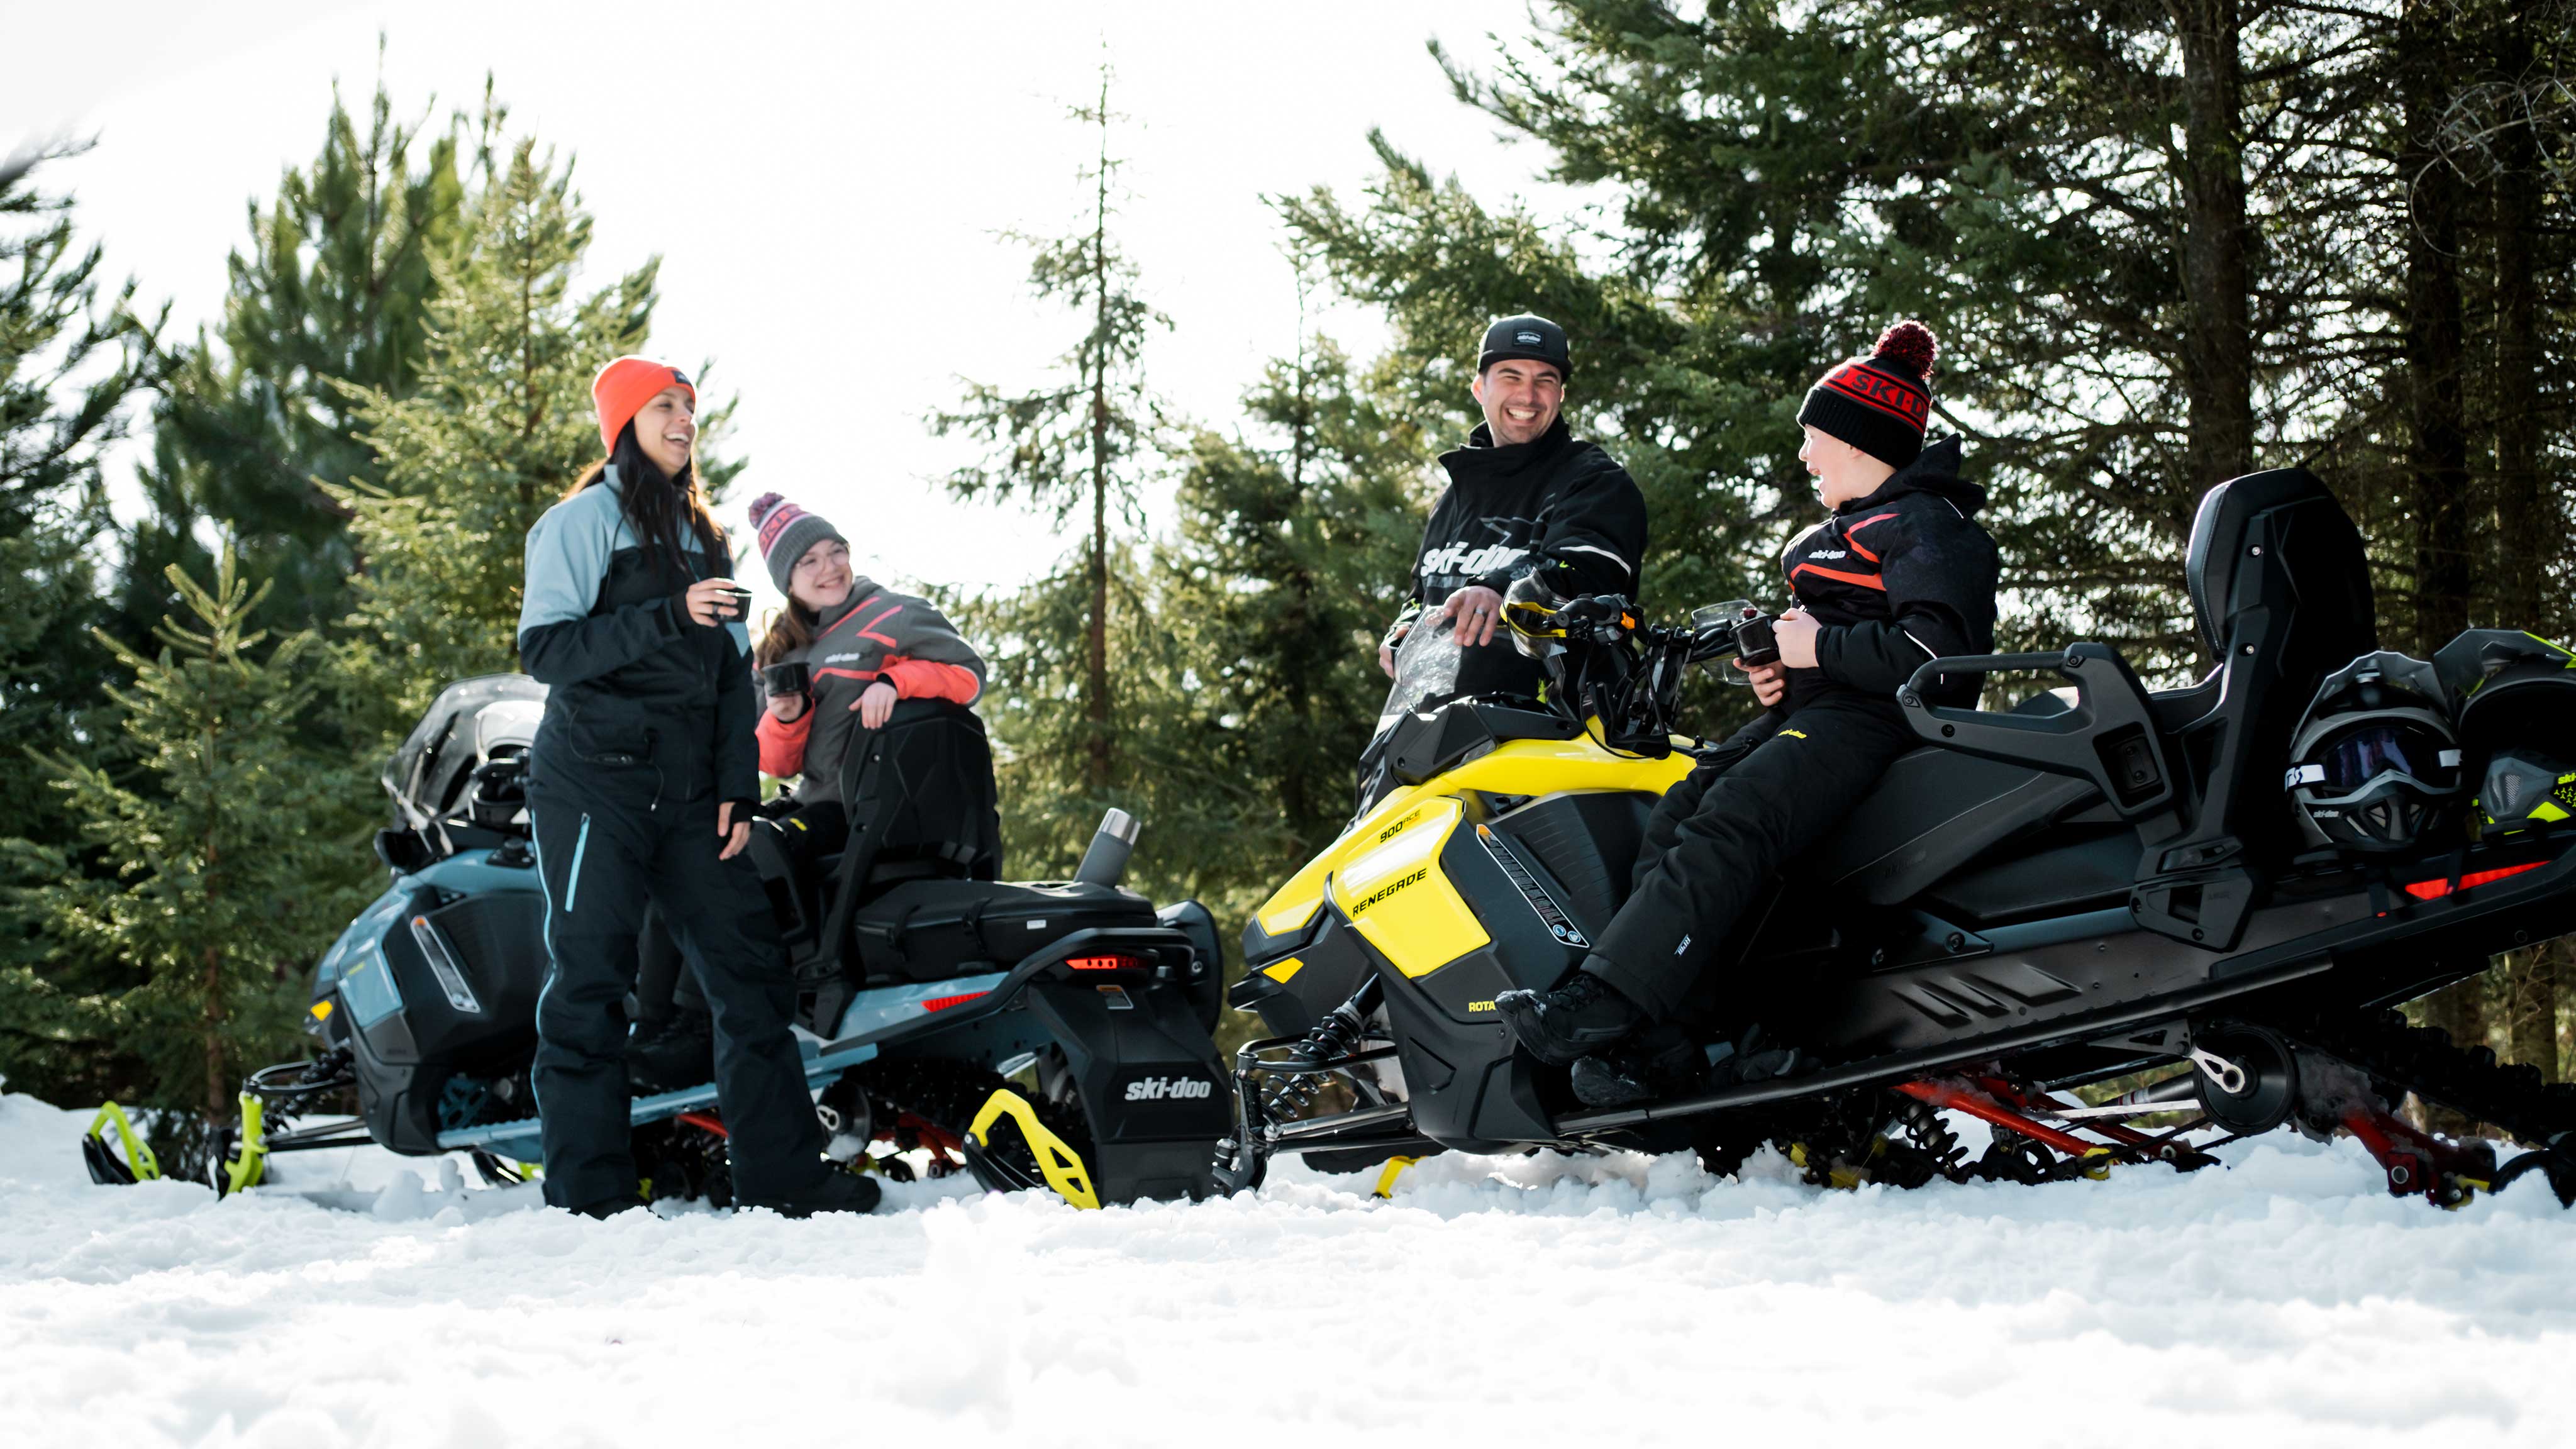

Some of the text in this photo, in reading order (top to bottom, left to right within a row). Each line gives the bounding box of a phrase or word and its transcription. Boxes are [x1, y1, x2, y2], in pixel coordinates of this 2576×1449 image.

[1380, 821, 1403, 843] 900
[1353, 867, 1427, 918] RENEGADE
[1124, 1076, 1211, 1101] ski-doo
